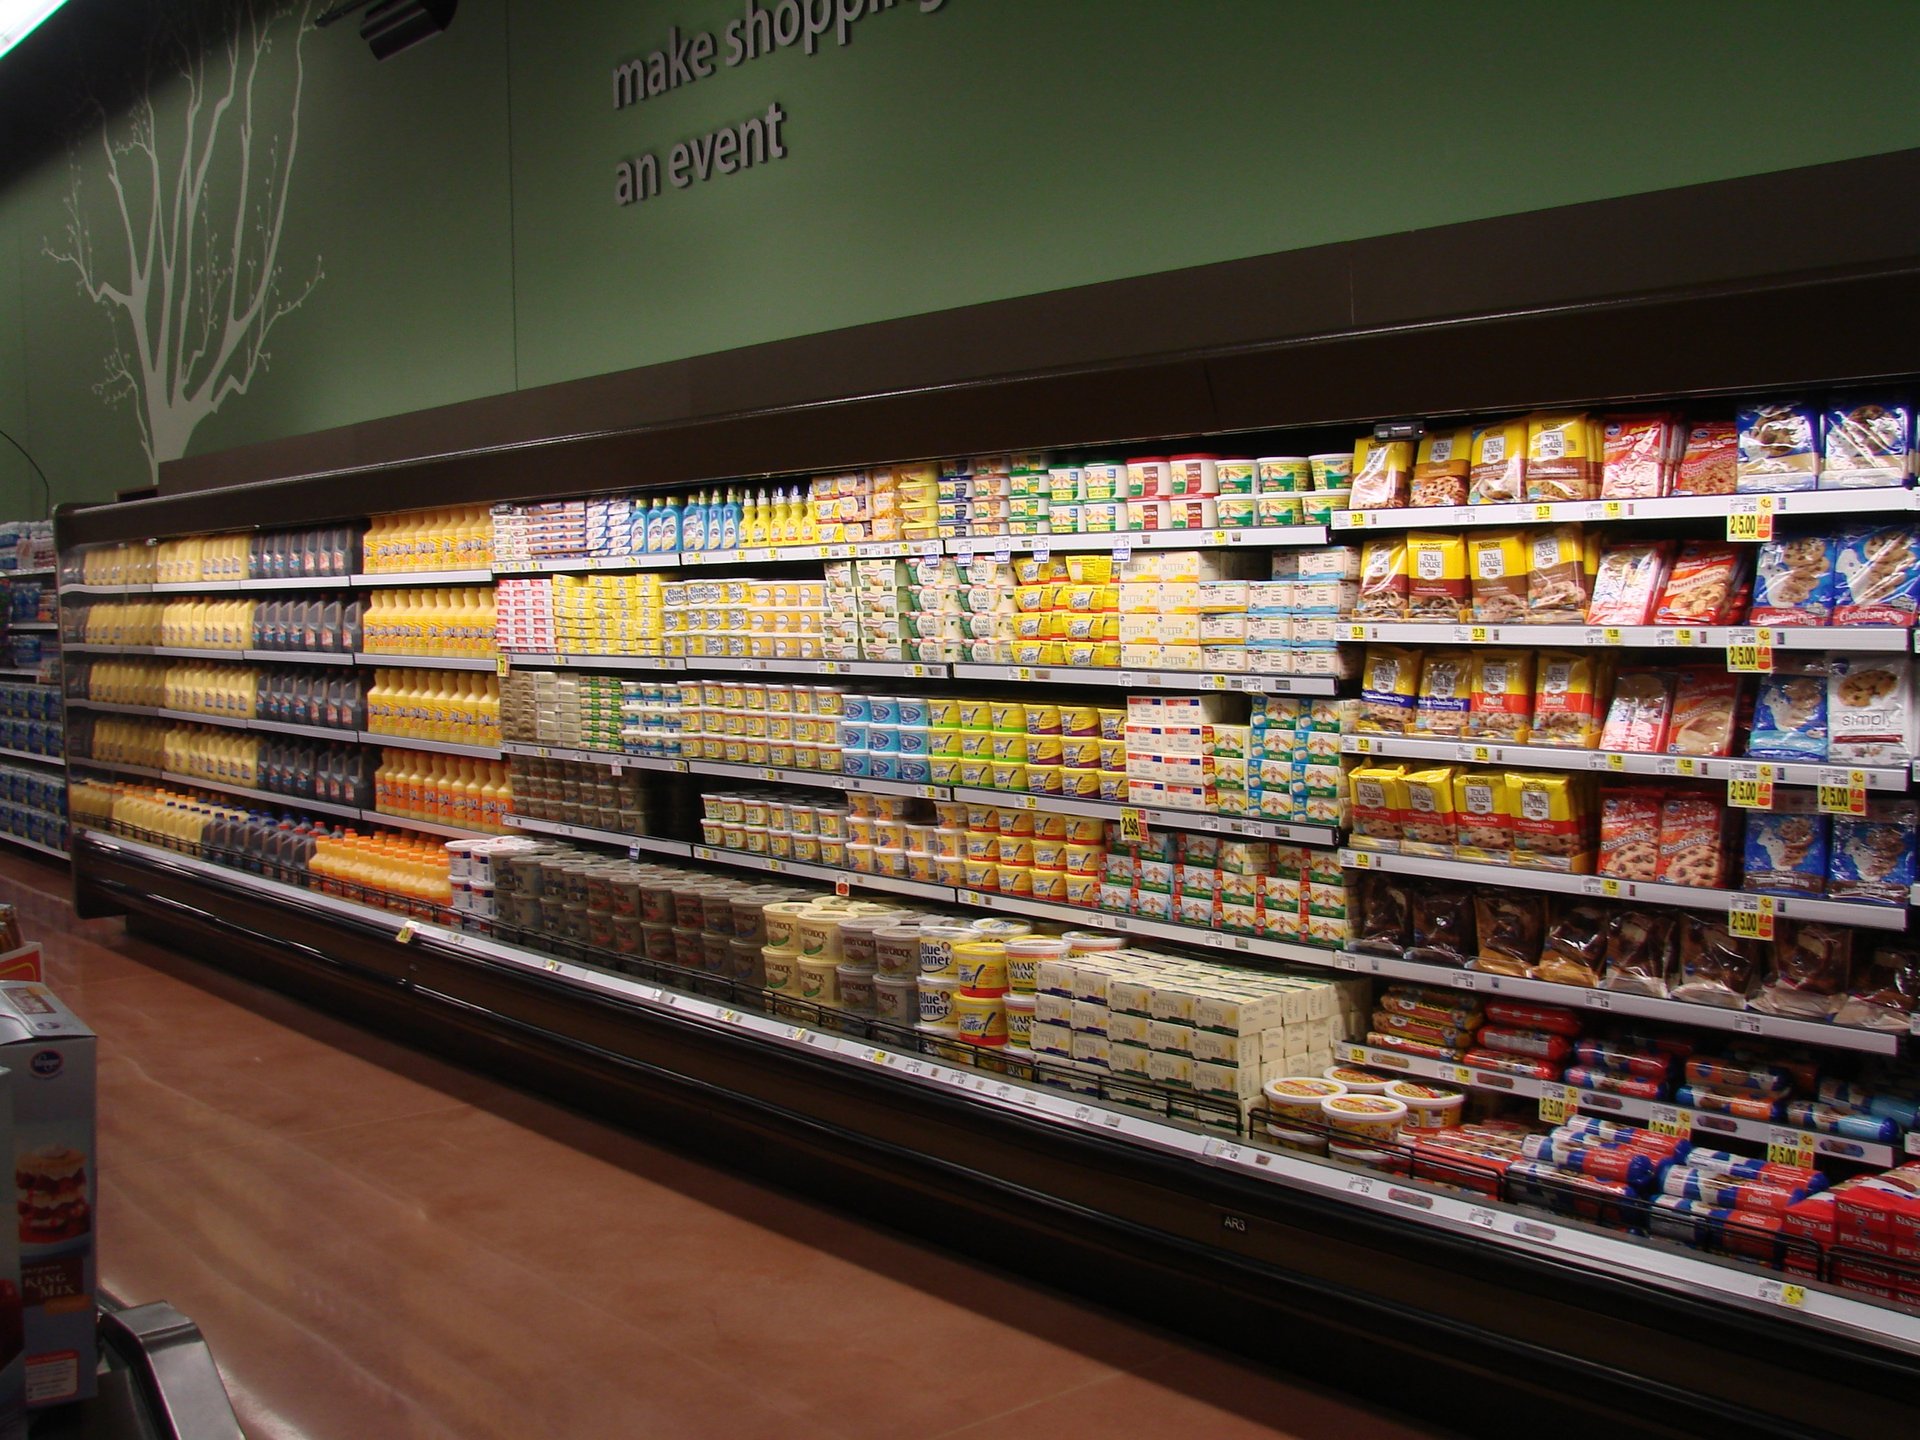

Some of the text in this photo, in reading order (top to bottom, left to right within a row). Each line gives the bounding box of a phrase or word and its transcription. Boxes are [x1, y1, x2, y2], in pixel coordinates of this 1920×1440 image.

[613, 0, 942, 108] make shopp
[615, 102, 786, 206] an event
[1536, 548, 1556, 558] HOUSE
[1480, 560, 1501, 568] HOUSE
[1840, 610, 1884, 622] Chocolate
[1470, 788, 1486, 796] TOLL
[1468, 795, 1490, 803] HOUSE
[1527, 794, 1542, 802] TOLL
[1524, 801, 1548, 810] HOUSE
[1122, 818, 1140, 836] 2.98
